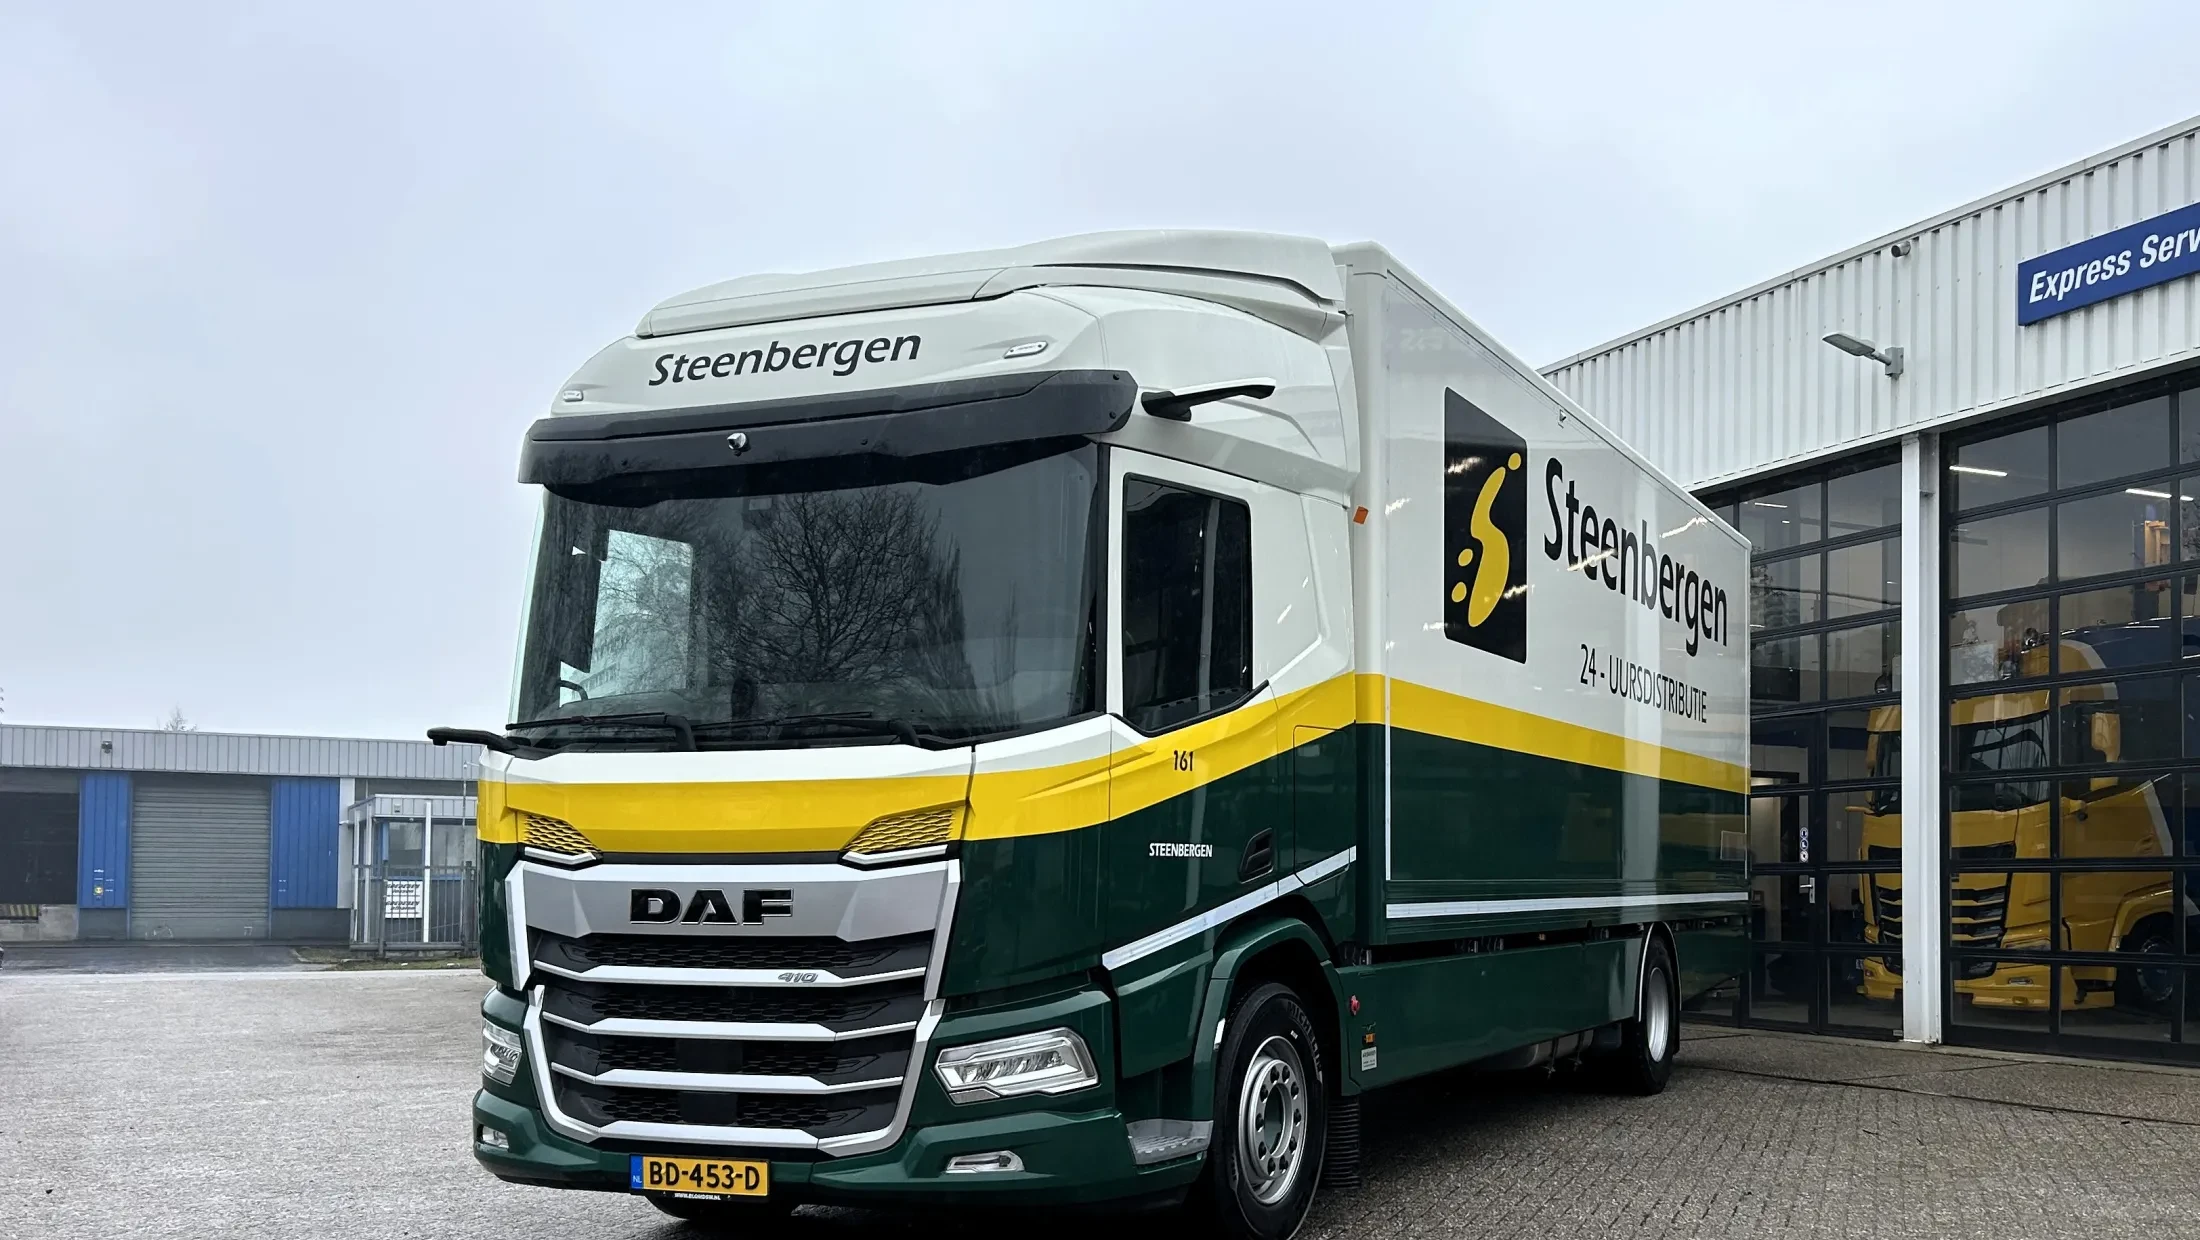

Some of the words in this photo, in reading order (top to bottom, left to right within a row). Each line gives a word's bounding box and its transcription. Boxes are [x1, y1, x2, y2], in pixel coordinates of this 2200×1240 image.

[2029, 250, 2132, 304] Express
[2140, 228, 2200, 268] Serv
[648, 334, 921, 386] Steenbergen
[1544, 457, 1728, 657] Steenbergen
[1609, 654, 1708, 724] UURSDISTRIBUTIE
[1173, 749, 1194, 772] 161
[1149, 842, 1213, 858] STEENBERGEN
[629, 888, 794, 926] DAF
[777, 971, 819, 984] 410
[632, 1174, 643, 1184] NL
[649, 1160, 760, 1191] BD-453-D
